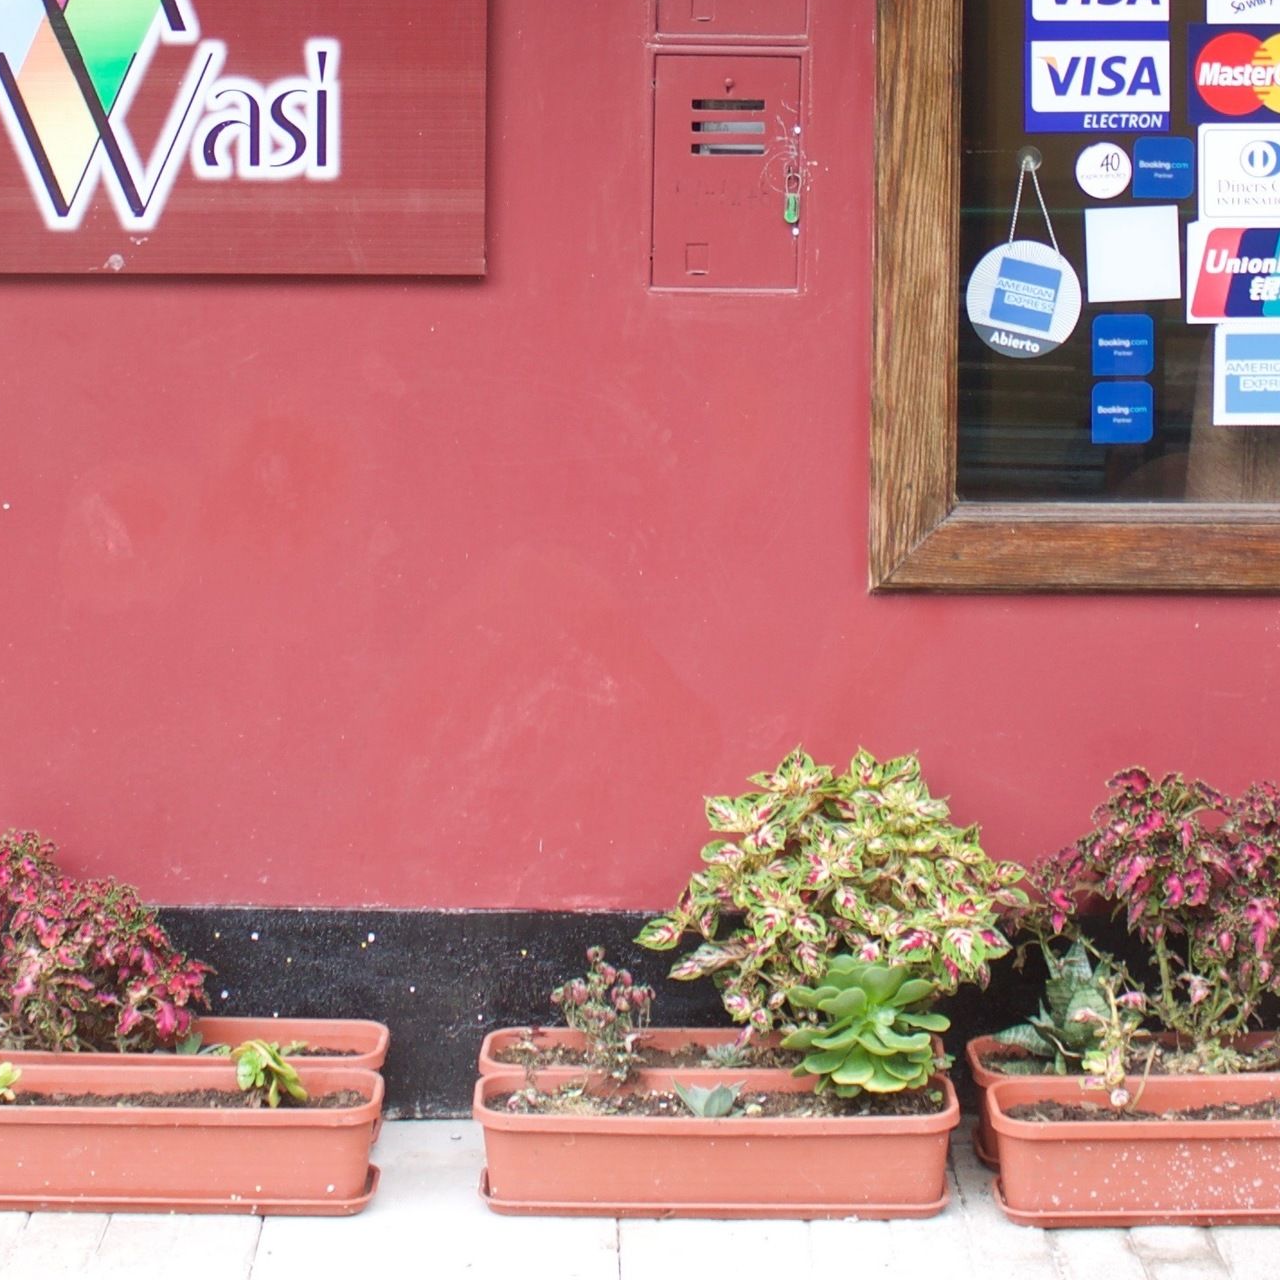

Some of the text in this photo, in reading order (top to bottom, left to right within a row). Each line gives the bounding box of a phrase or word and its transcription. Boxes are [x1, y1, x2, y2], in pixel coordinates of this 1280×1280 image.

[1230, 0, 1246, 14] So
[1039, 56, 1162, 96] VISA
[1083, 113, 1163, 129] ELECTRON
[1138, 160, 1189, 170] Booking.com
[1217, 178, 1267, 194] Diners
[997, 278, 1053, 300] AMERICAN
[1006, 294, 1055, 313] EXPRESS
[990, 330, 1040, 353] Abierto
[1097, 337, 1148, 348] Booking.com
[1096, 405, 1147, 416] Booking.com
